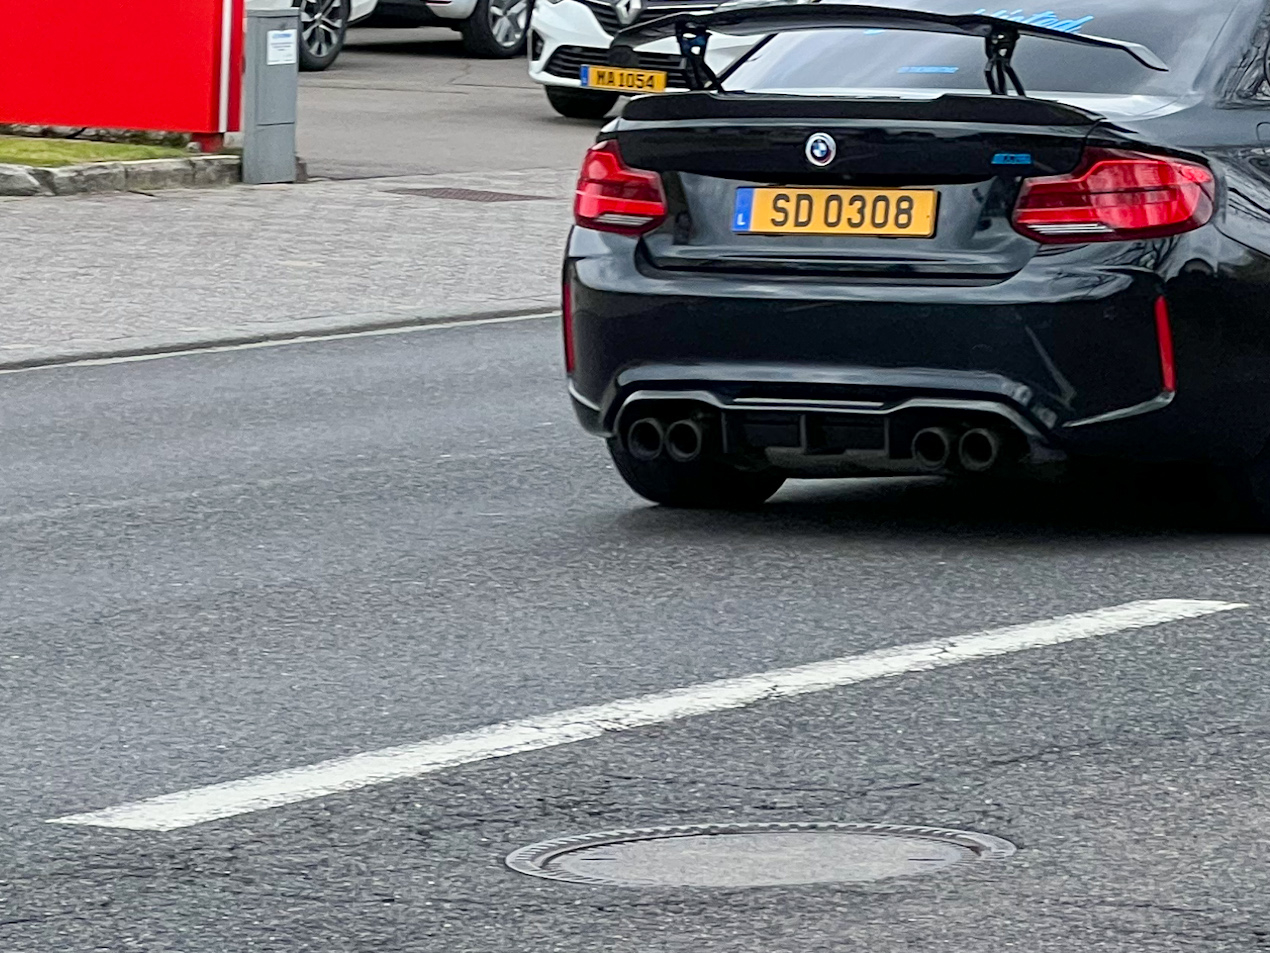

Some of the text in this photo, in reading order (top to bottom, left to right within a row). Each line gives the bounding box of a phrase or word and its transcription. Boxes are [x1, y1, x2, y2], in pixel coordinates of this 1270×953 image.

[618, 72, 655, 89] 1054
[770, 193, 915, 229] SD 0308
